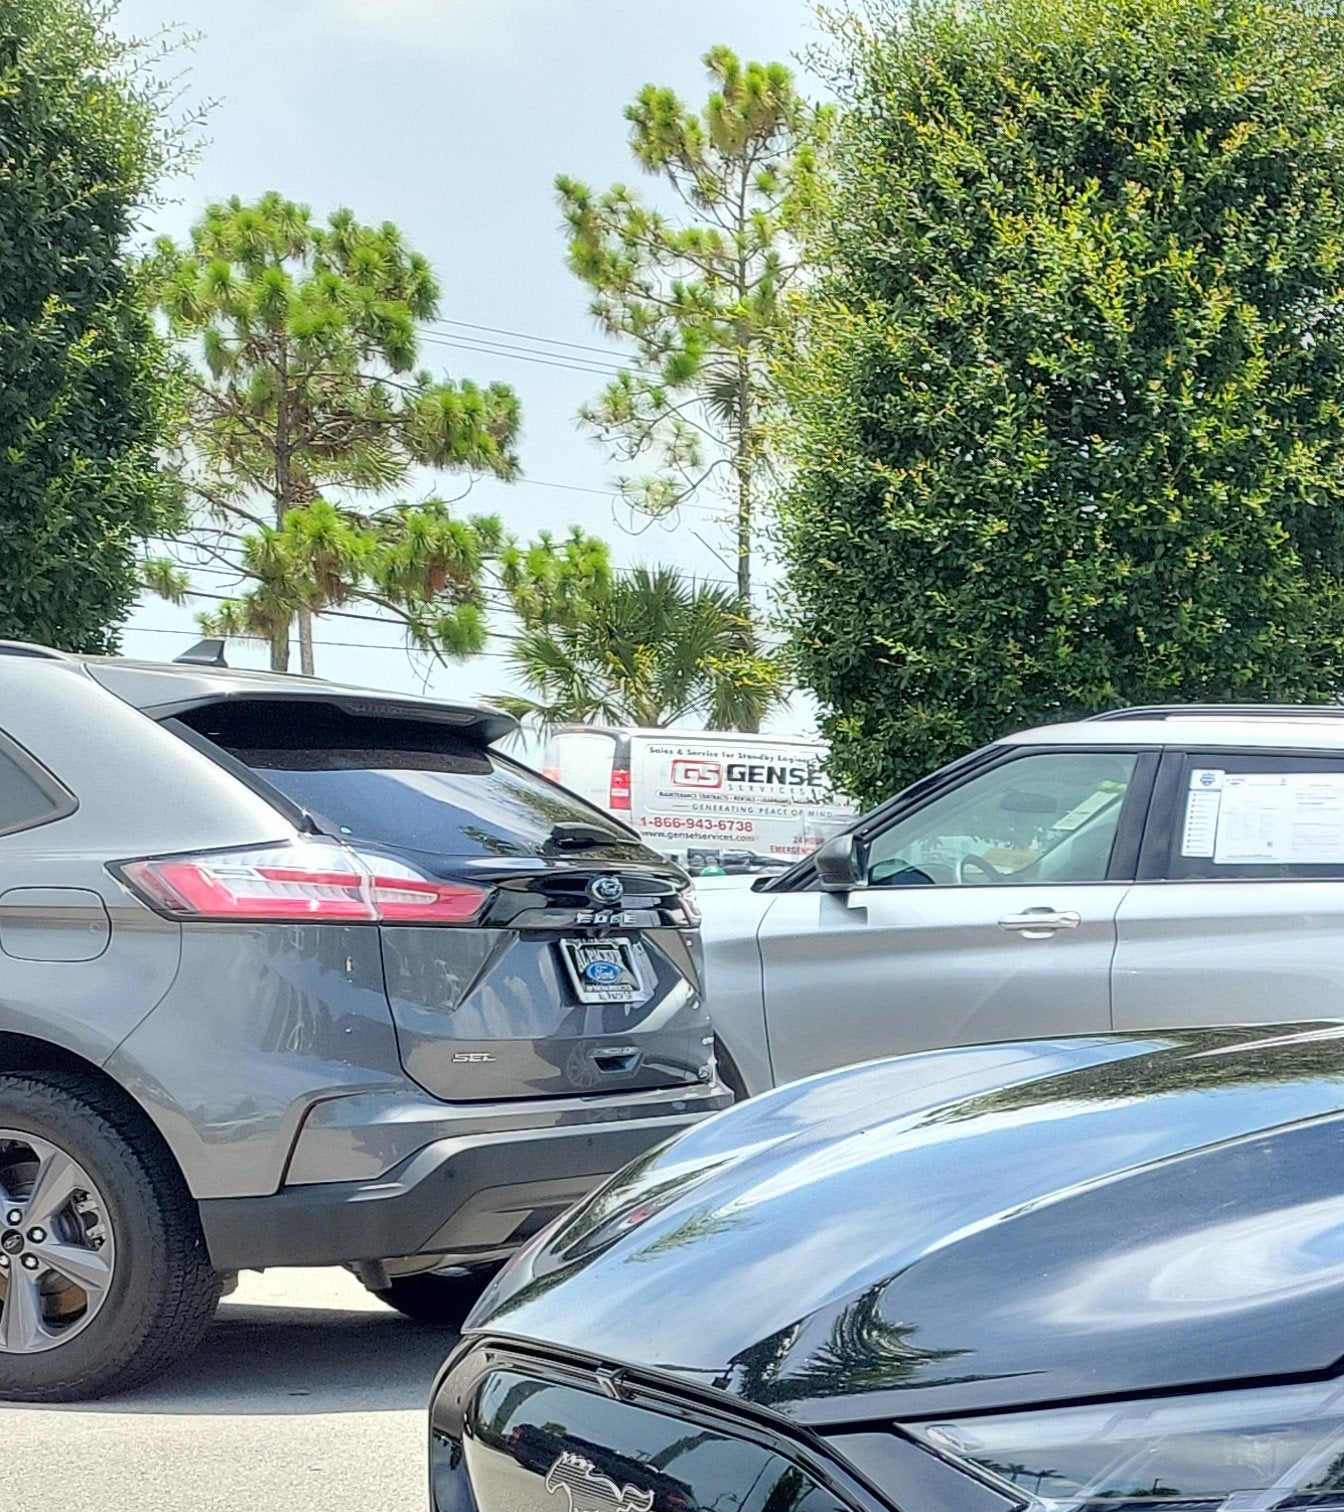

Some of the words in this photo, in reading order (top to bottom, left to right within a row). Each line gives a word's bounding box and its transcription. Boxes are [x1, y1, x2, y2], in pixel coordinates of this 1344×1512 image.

[649, 746, 674, 755] Sales
[687, 748, 719, 758] Service
[738, 752, 774, 763] Standby
[727, 763, 823, 787] GENSE
[692, 803, 754, 814] GENERATING
[759, 807, 788, 816] PEACE
[808, 811, 833, 819] MIND
[640, 816, 753, 832] 1-866-943-6738
[576, 909, 637, 924] EDGE
[452, 1052, 498, 1063] SEL
